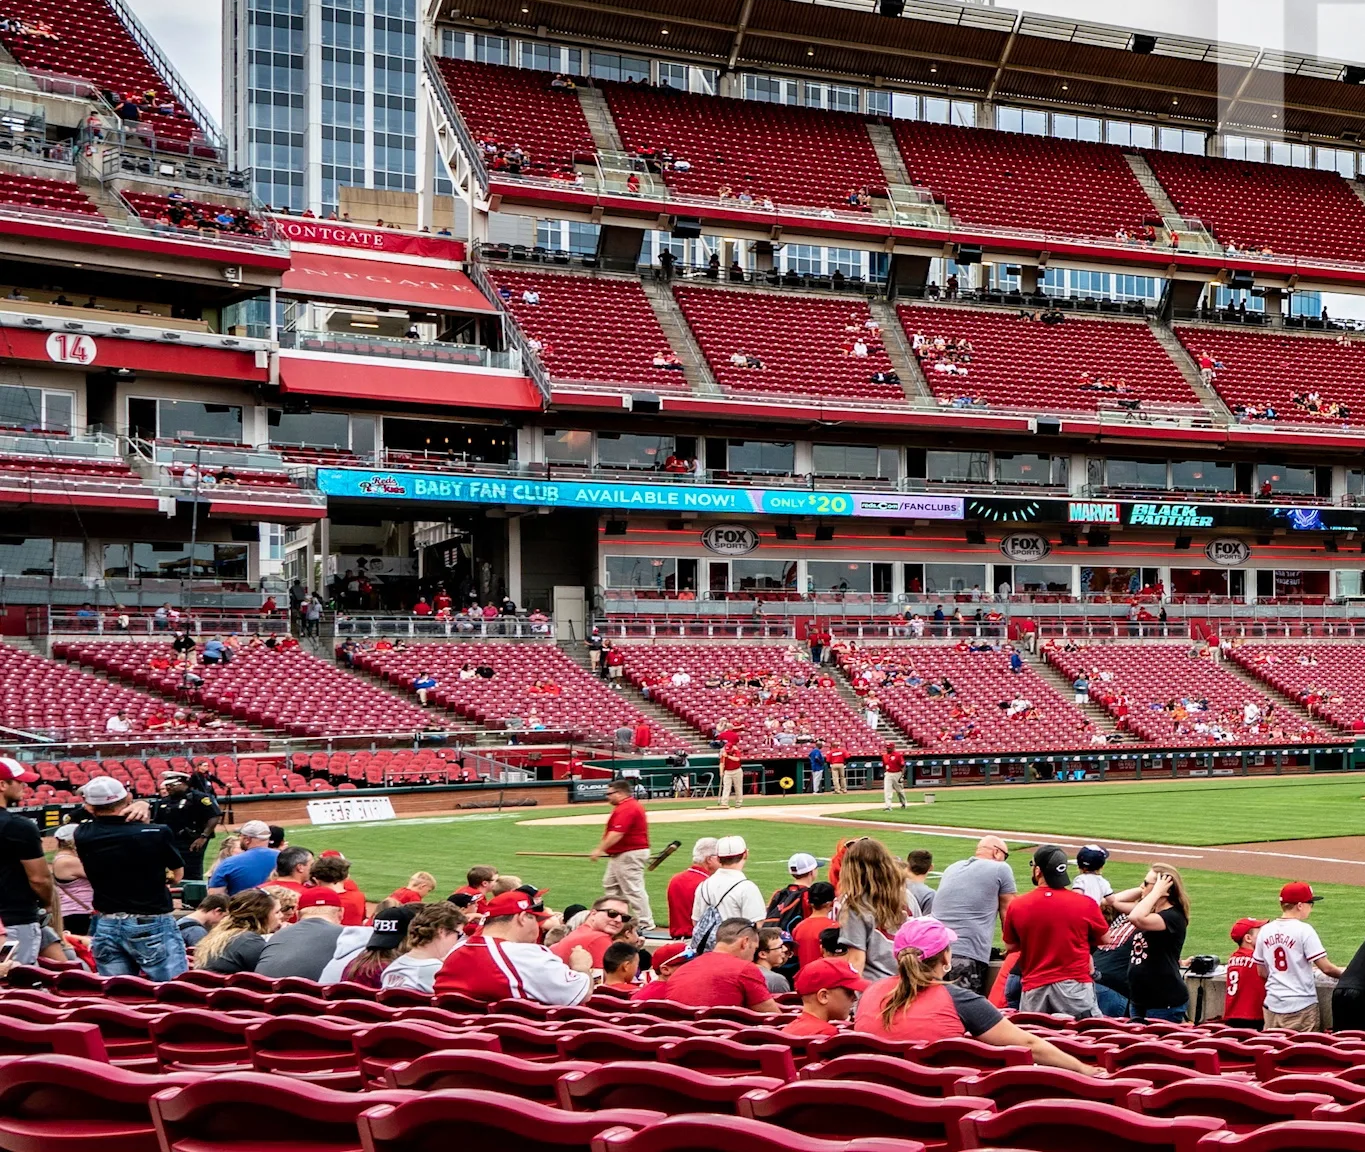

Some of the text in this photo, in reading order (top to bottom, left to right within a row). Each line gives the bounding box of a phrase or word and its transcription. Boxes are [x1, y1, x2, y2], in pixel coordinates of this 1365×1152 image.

[55, 333, 89, 362] 14
[372, 476, 397, 484] Reds
[415, 479, 735, 507] BABY FAN CLUB AVAILABLE NOW!
[770, 495, 846, 513] ONLY $20
[1132, 504, 1200, 517] BLACK
[1069, 503, 1120, 522] MARVEL
[1129, 514, 1214, 527] PANTHER
[715, 529, 748, 543] FOX
[1011, 538, 1040, 550] FOX
[1215, 543, 1241, 555] FOX
[374, 920, 398, 931] FBI
[1264, 933, 1296, 949] MORGAN
[1274, 947, 1288, 972] 8
[1228, 971, 1239, 996] 3
